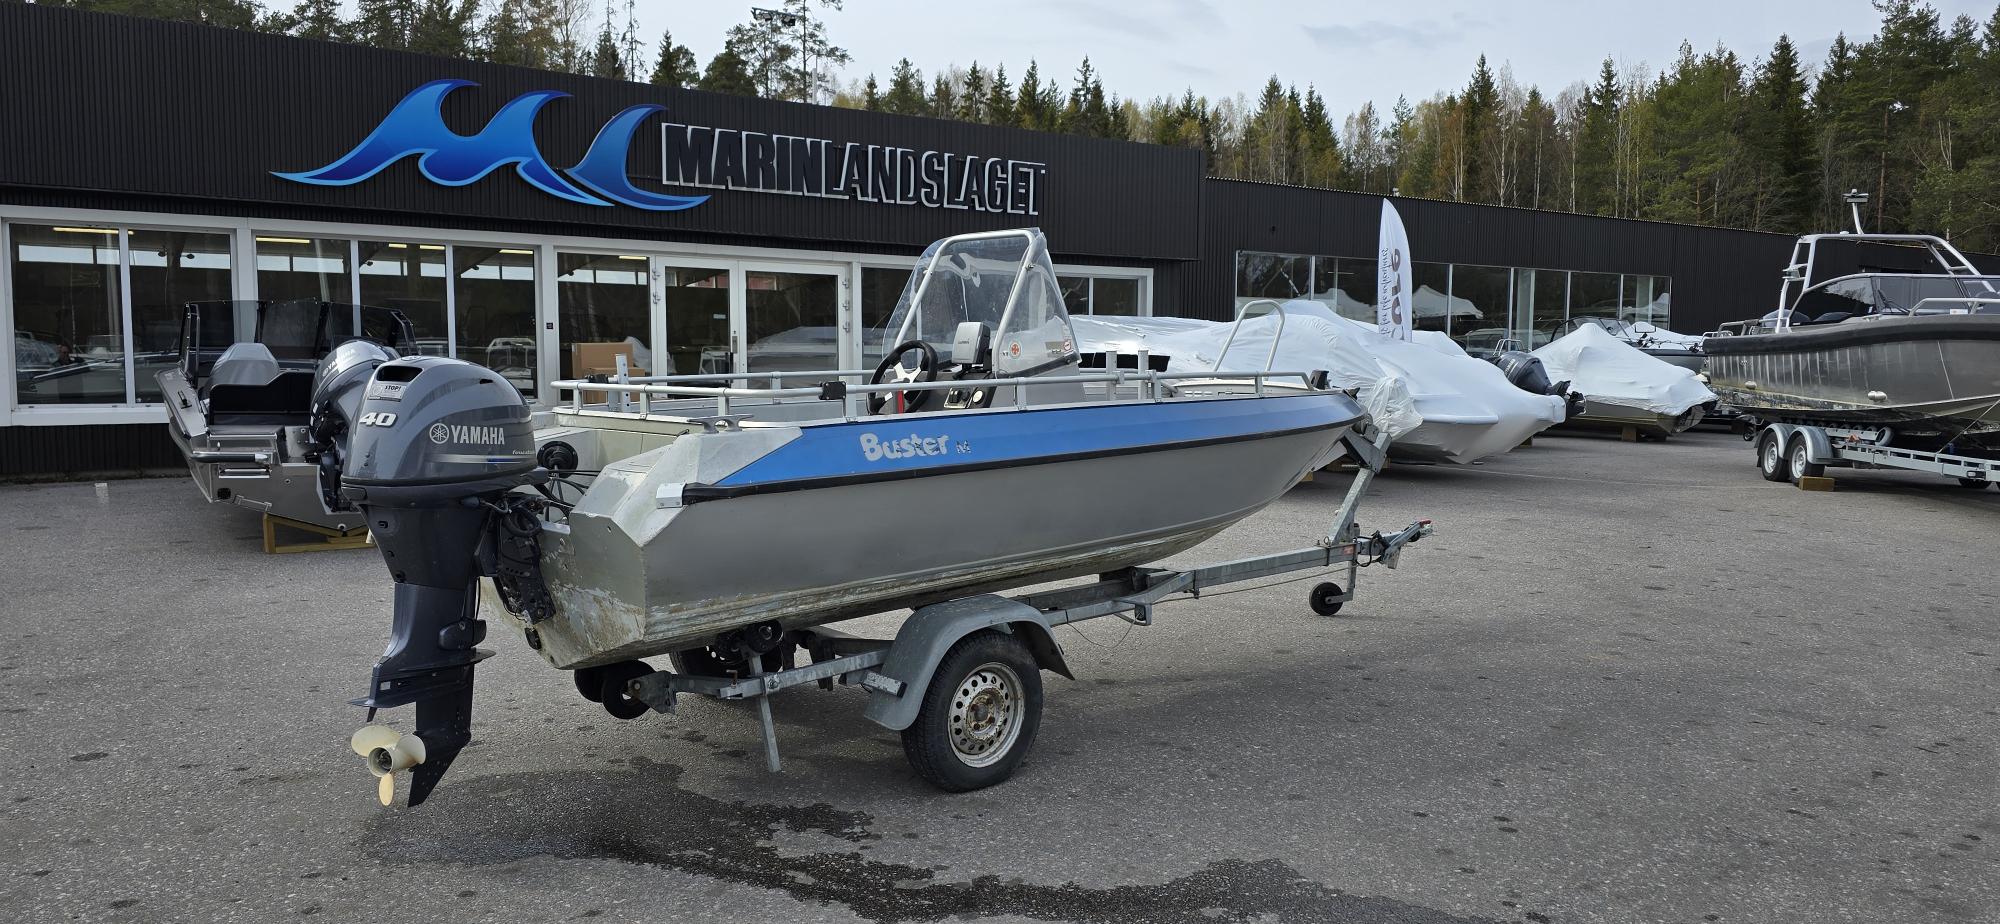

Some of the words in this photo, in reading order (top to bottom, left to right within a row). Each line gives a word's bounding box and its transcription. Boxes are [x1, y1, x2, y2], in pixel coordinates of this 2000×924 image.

[662, 122, 1046, 215] MARINLANDSLAGET
[359, 412, 398, 427] 40
[451, 425, 505, 445] YAMAHA
[860, 433, 949, 462] Buster
